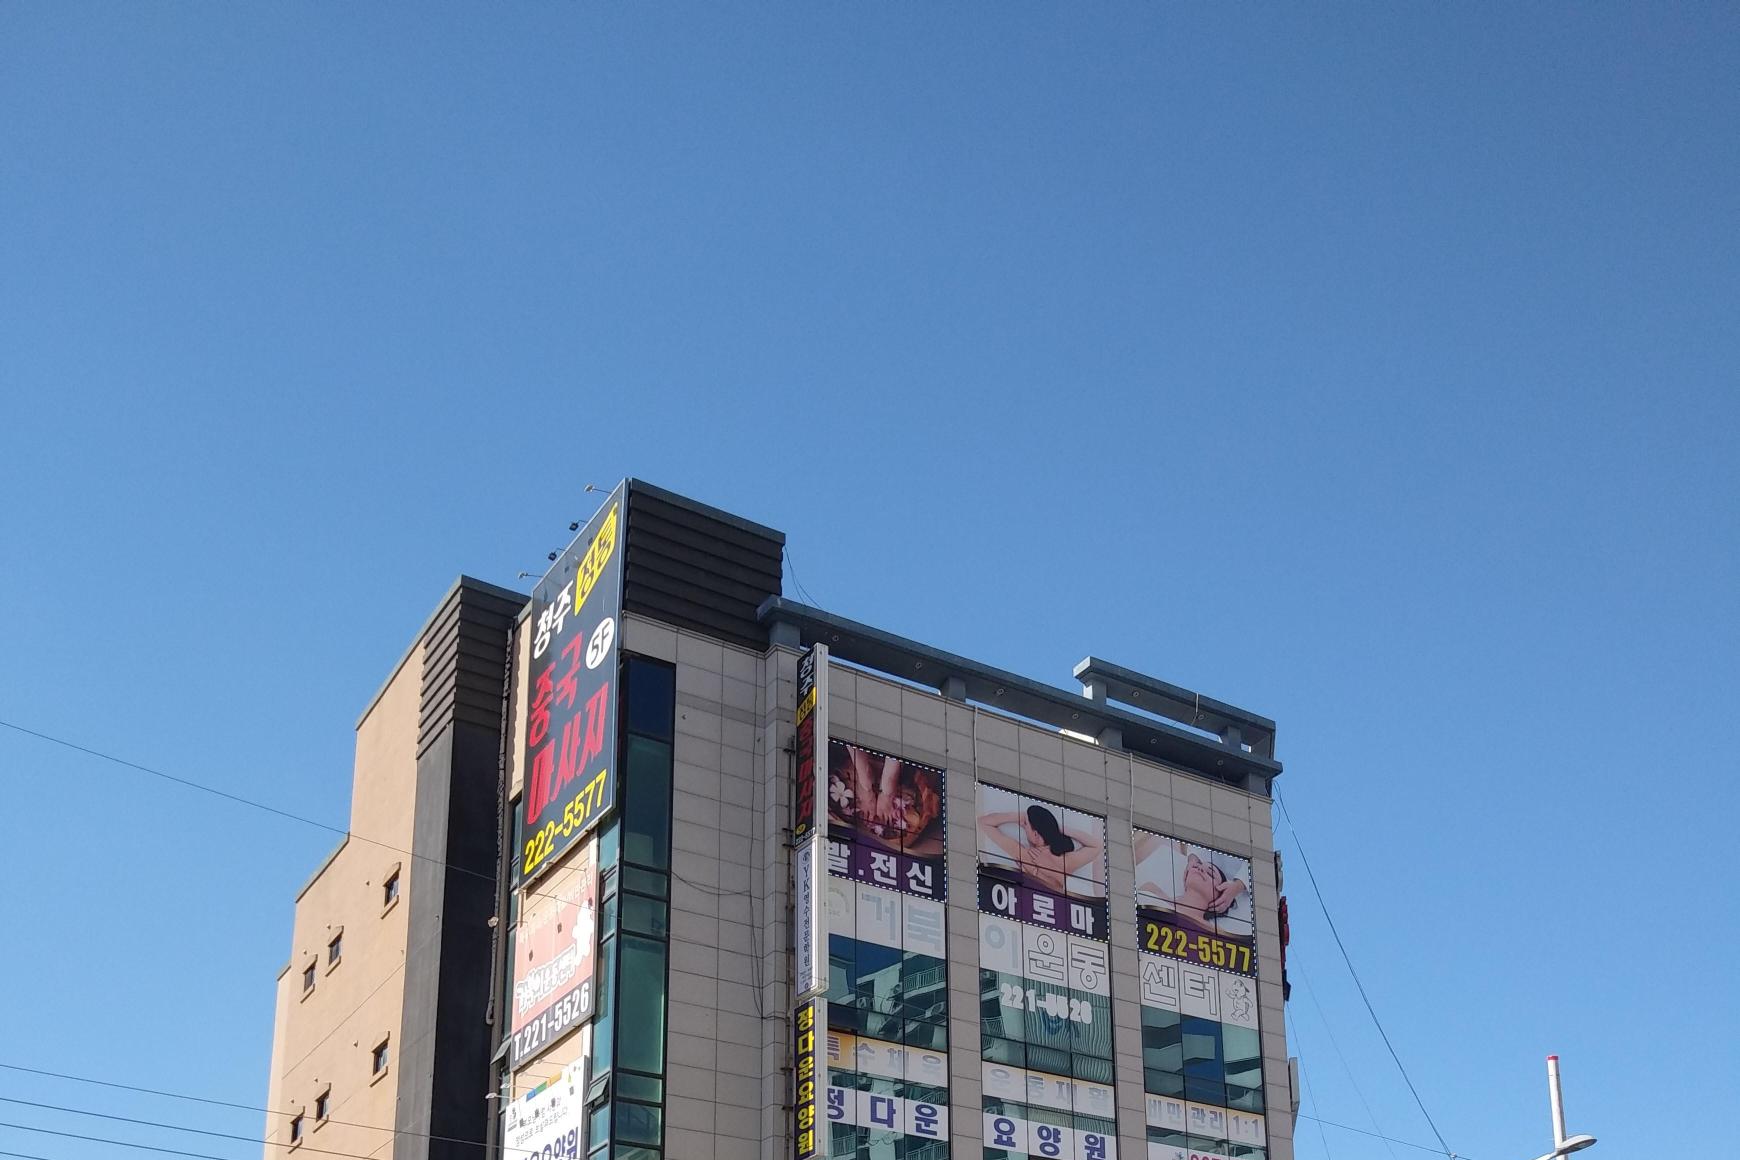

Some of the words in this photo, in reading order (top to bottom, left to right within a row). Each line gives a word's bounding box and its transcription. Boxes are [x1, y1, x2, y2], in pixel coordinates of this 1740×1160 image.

[533, 580, 573, 660] 청주
[528, 632, 582, 747] 중국
[799, 649, 814, 696] 청주
[528, 682, 609, 825] 마사지
[524, 768, 607, 875] 222-5577
[991, 883, 1095, 935] 아로마
[1146, 923, 1251, 973] 222-5577
[514, 981, 591, 1061] T.221-5526
[798, 1006, 814, 1155] 정다운요양원
